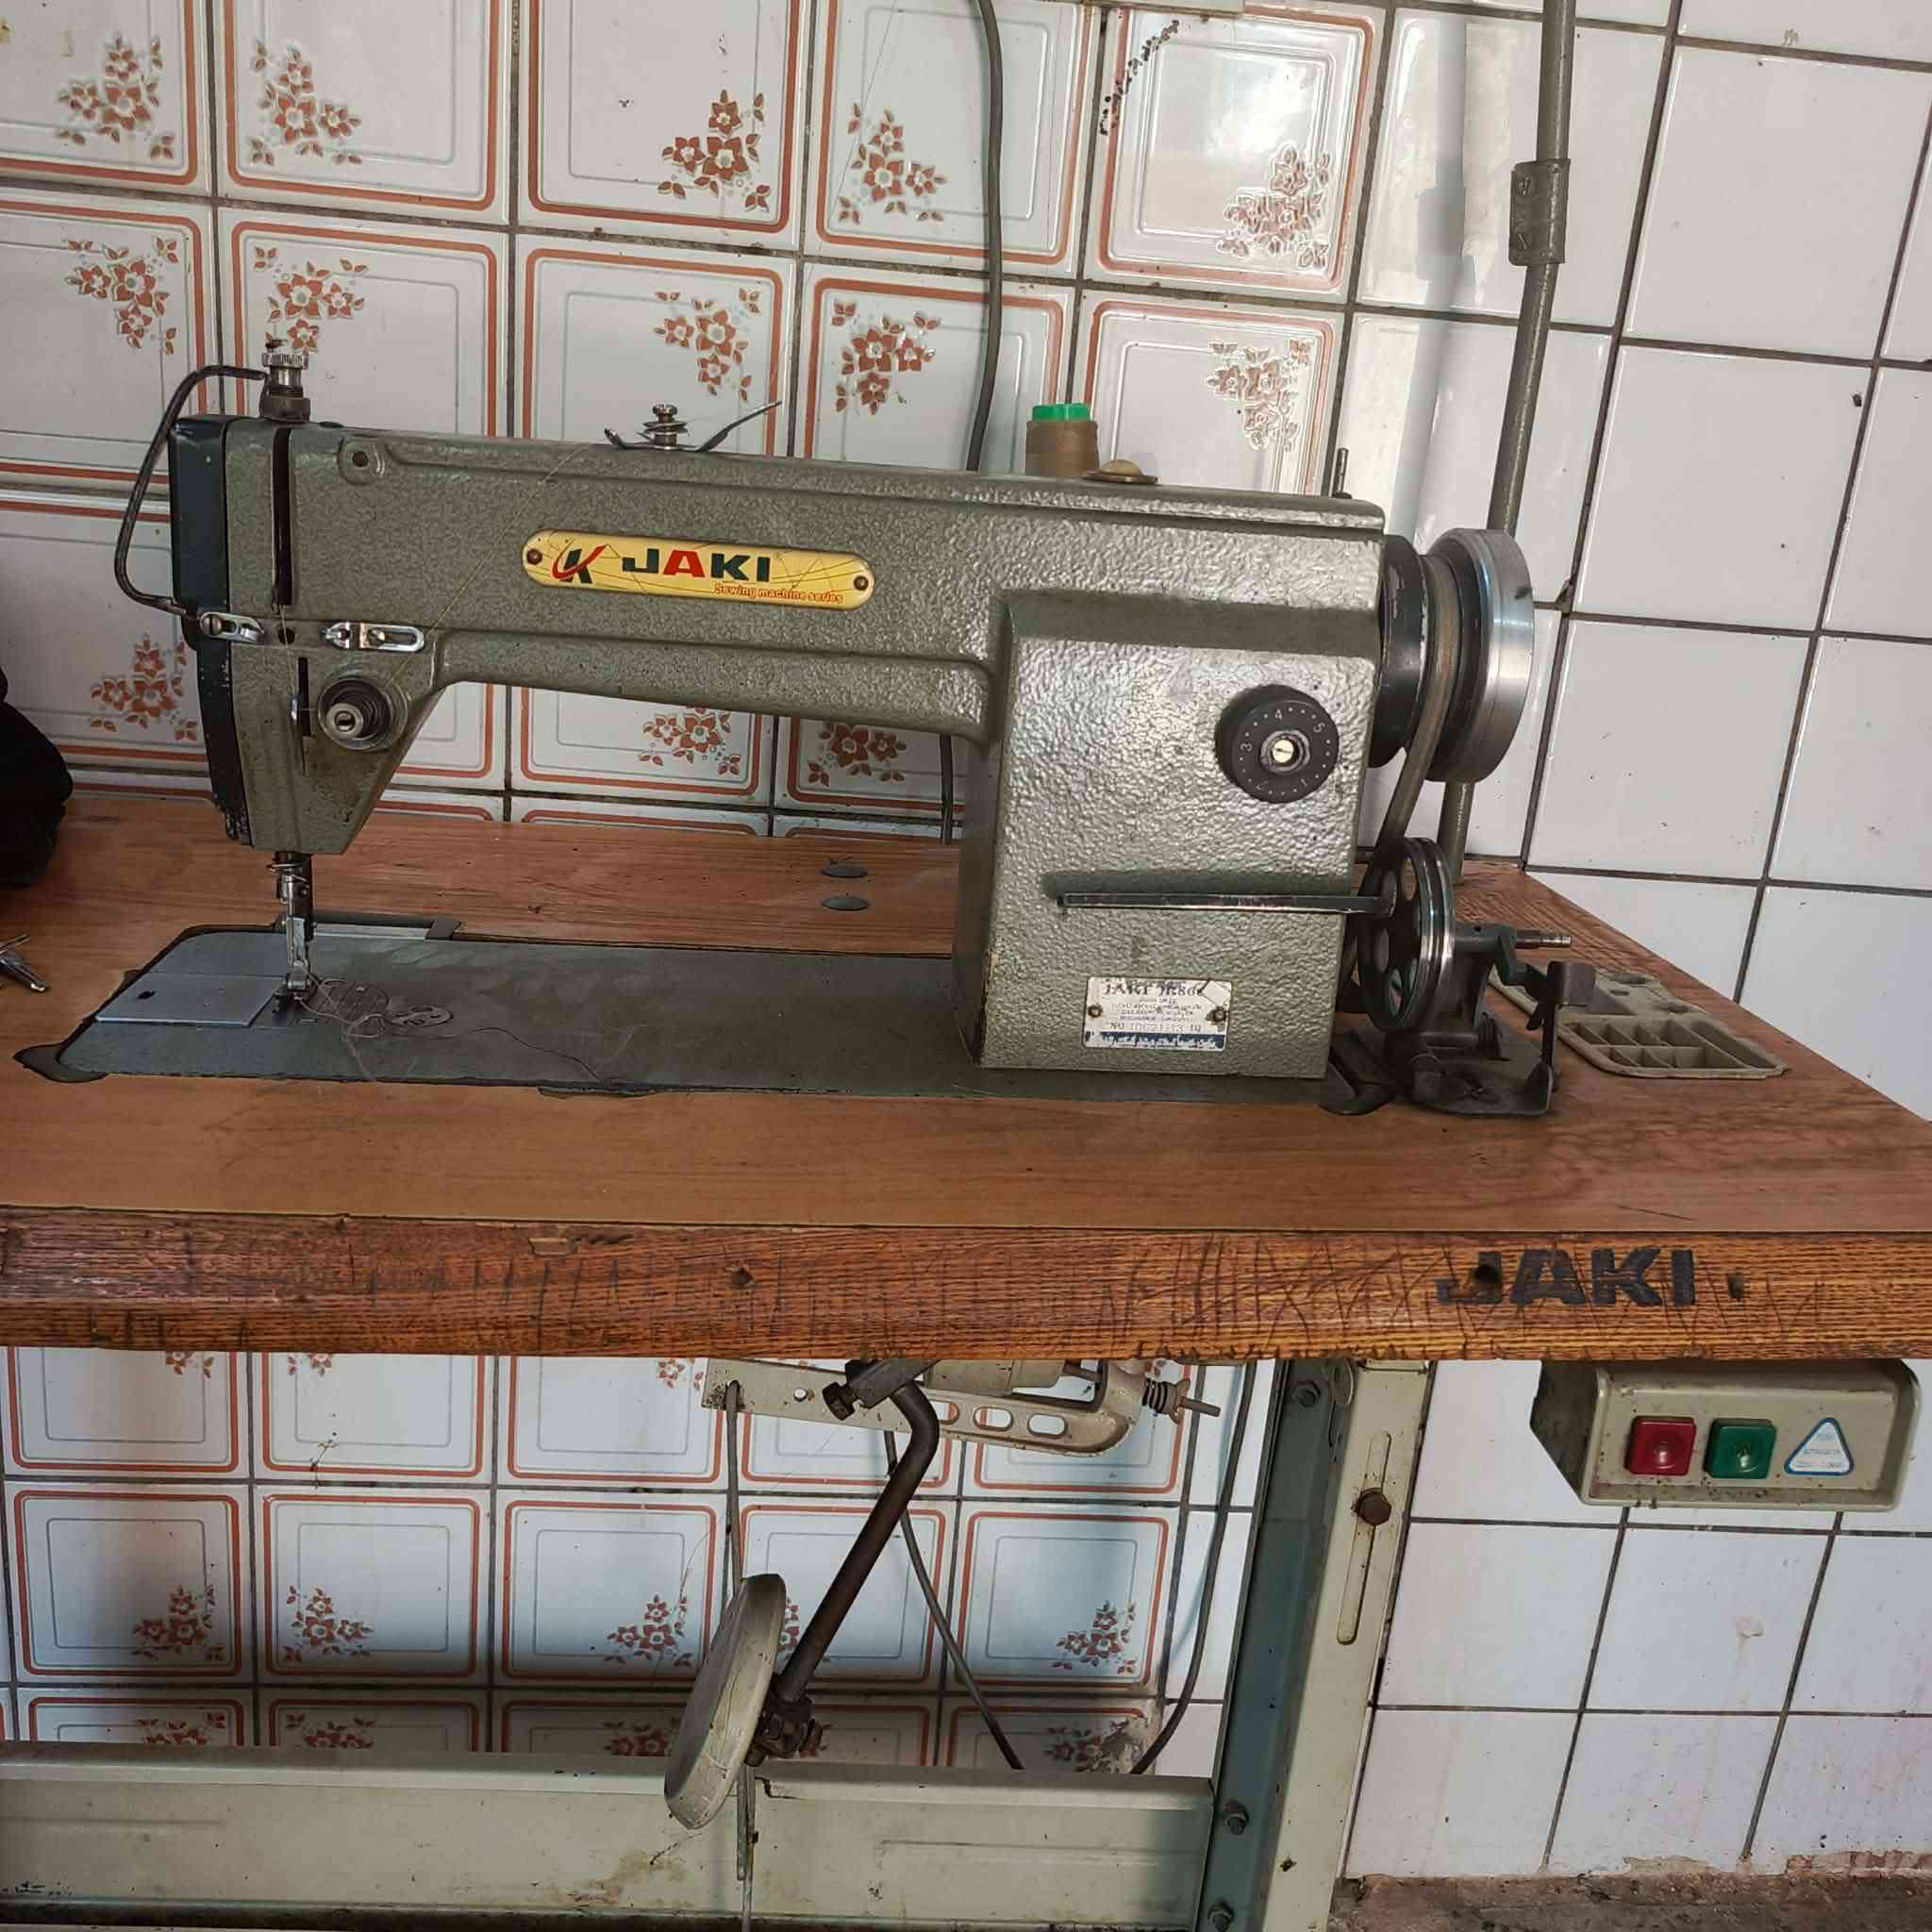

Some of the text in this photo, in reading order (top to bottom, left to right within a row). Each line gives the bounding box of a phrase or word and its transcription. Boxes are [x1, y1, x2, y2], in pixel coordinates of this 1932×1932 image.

[623, 548, 771, 583] JAKI
[713, 583, 844, 605] Sewing machine series
[1435, 1247, 1696, 1307] JAKI
